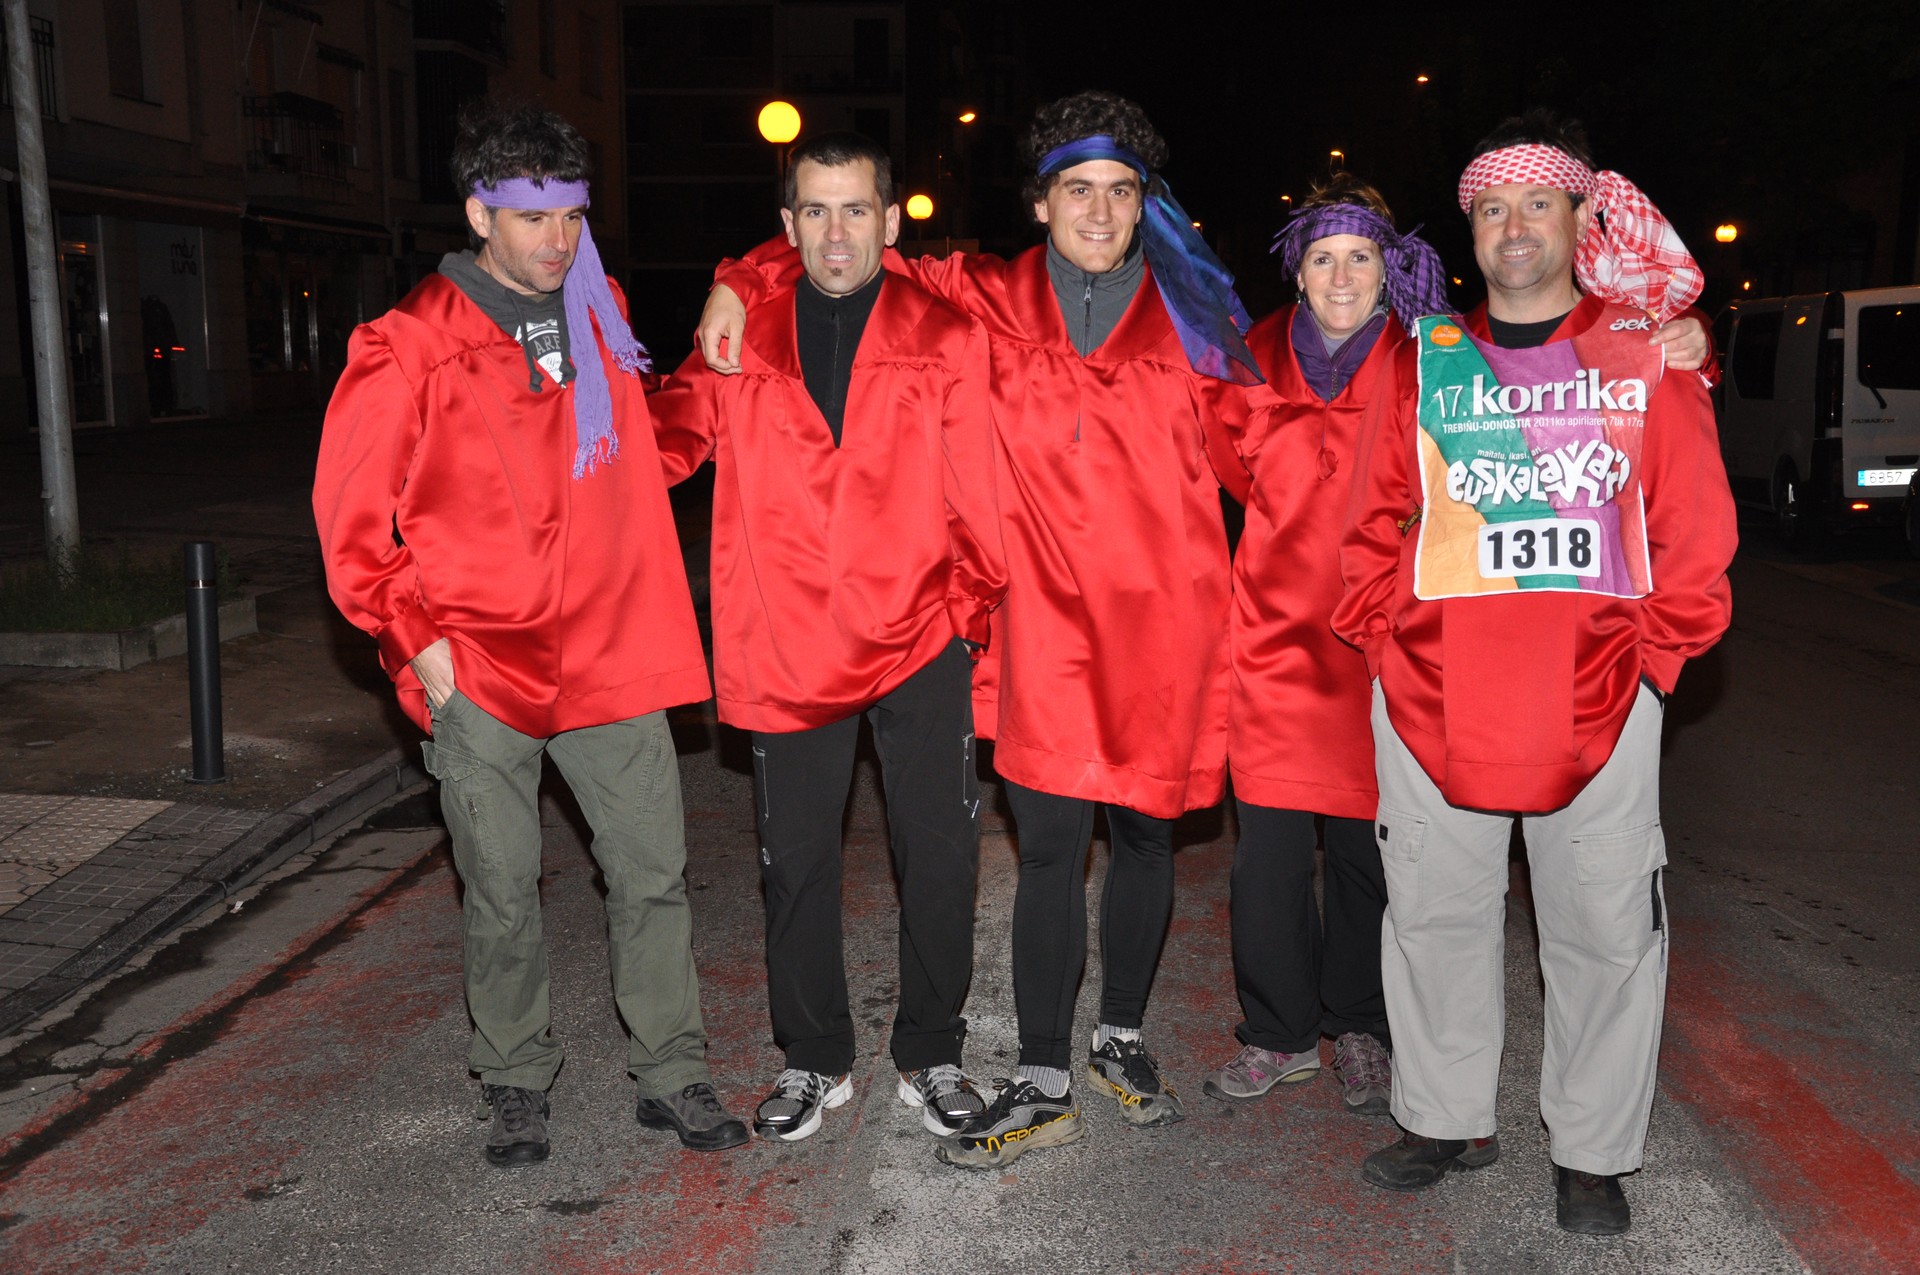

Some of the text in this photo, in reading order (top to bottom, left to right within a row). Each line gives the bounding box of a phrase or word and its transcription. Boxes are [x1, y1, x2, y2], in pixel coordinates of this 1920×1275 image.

[1609, 315, 1653, 331] aek
[1432, 369, 1648, 419] 17. korrika
[1442, 418, 1531, 434] TREBIÑU-DONOSTIA
[1533, 416, 1566, 428] 2011ko
[1567, 415, 1607, 428] apirilaren
[1869, 471, 1902, 484] 6357
[1487, 527, 1592, 570] 1318
